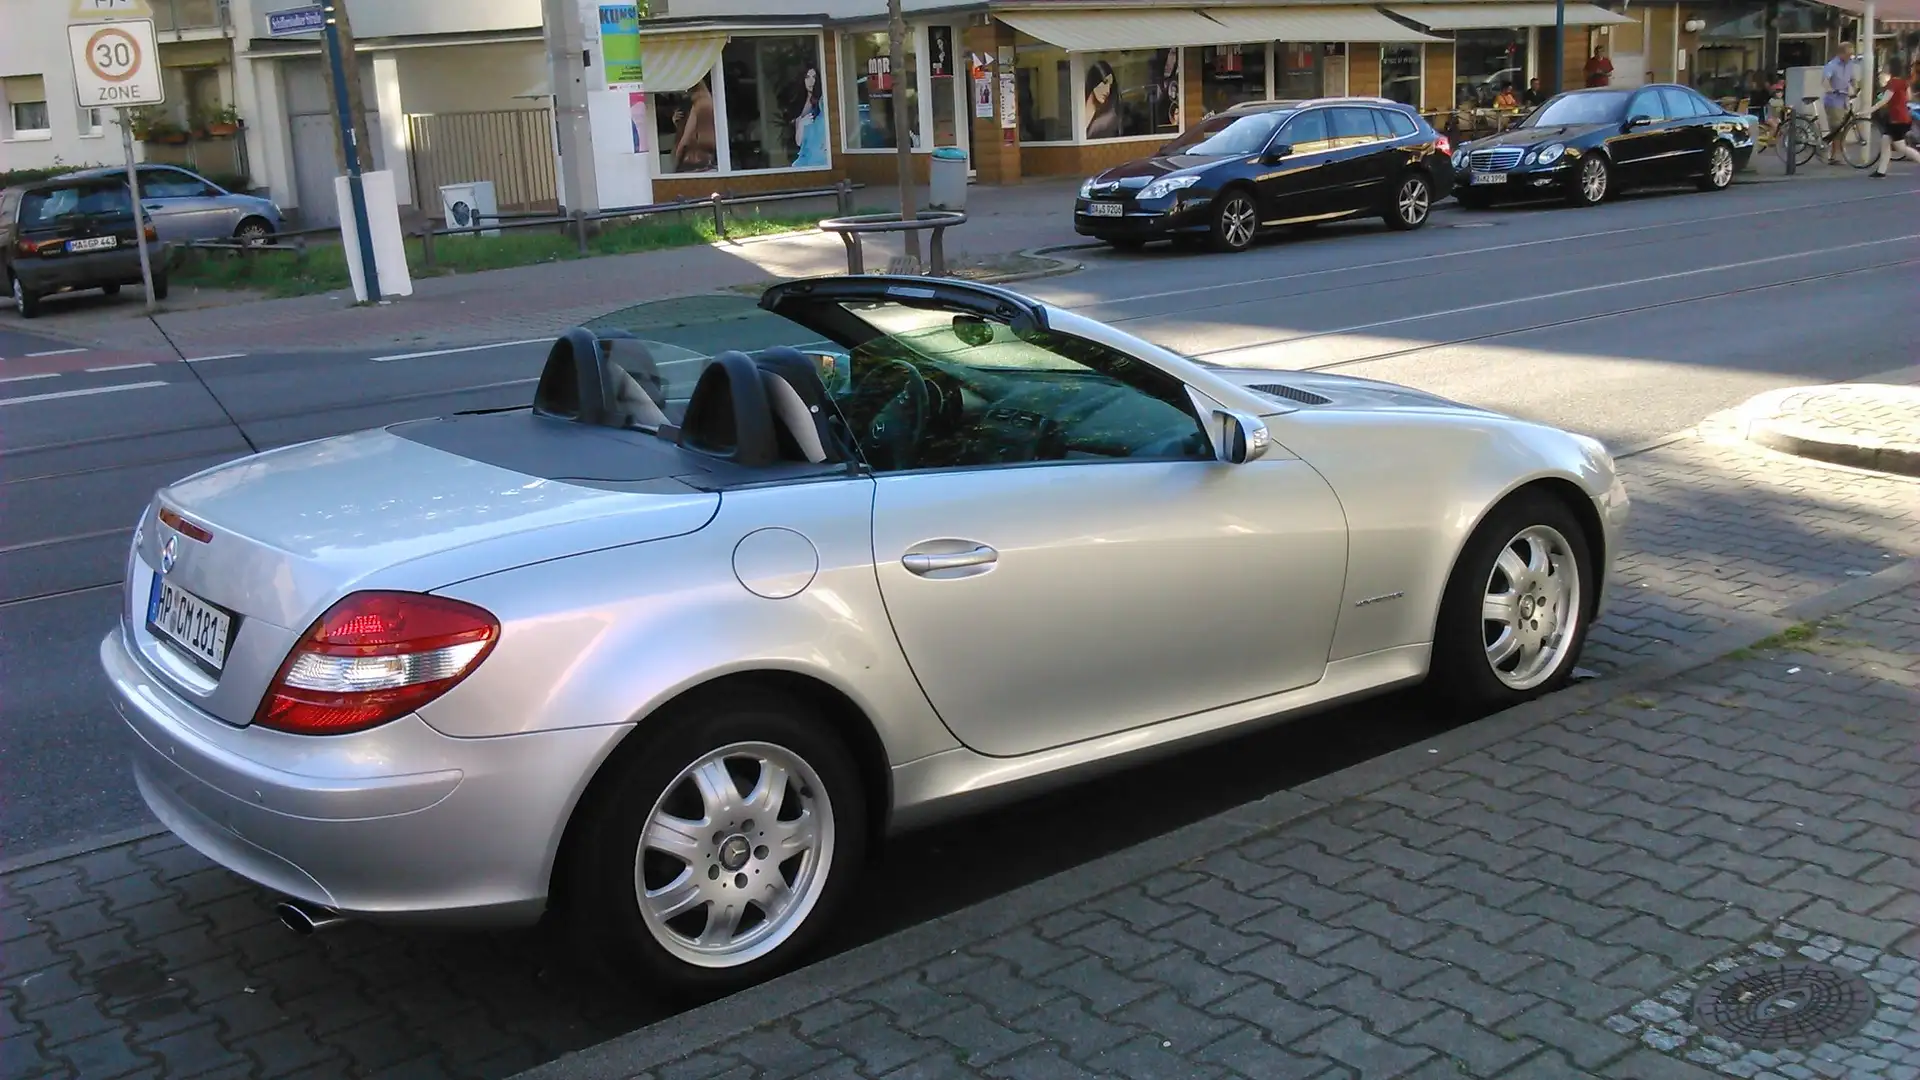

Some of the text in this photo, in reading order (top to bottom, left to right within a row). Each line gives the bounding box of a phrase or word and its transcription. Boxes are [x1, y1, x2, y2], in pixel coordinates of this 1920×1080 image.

[97, 43, 129, 67] 30
[99, 85, 140, 100] ZONE
[159, 582, 173, 624] HP
[192, 607, 218, 658] 181
